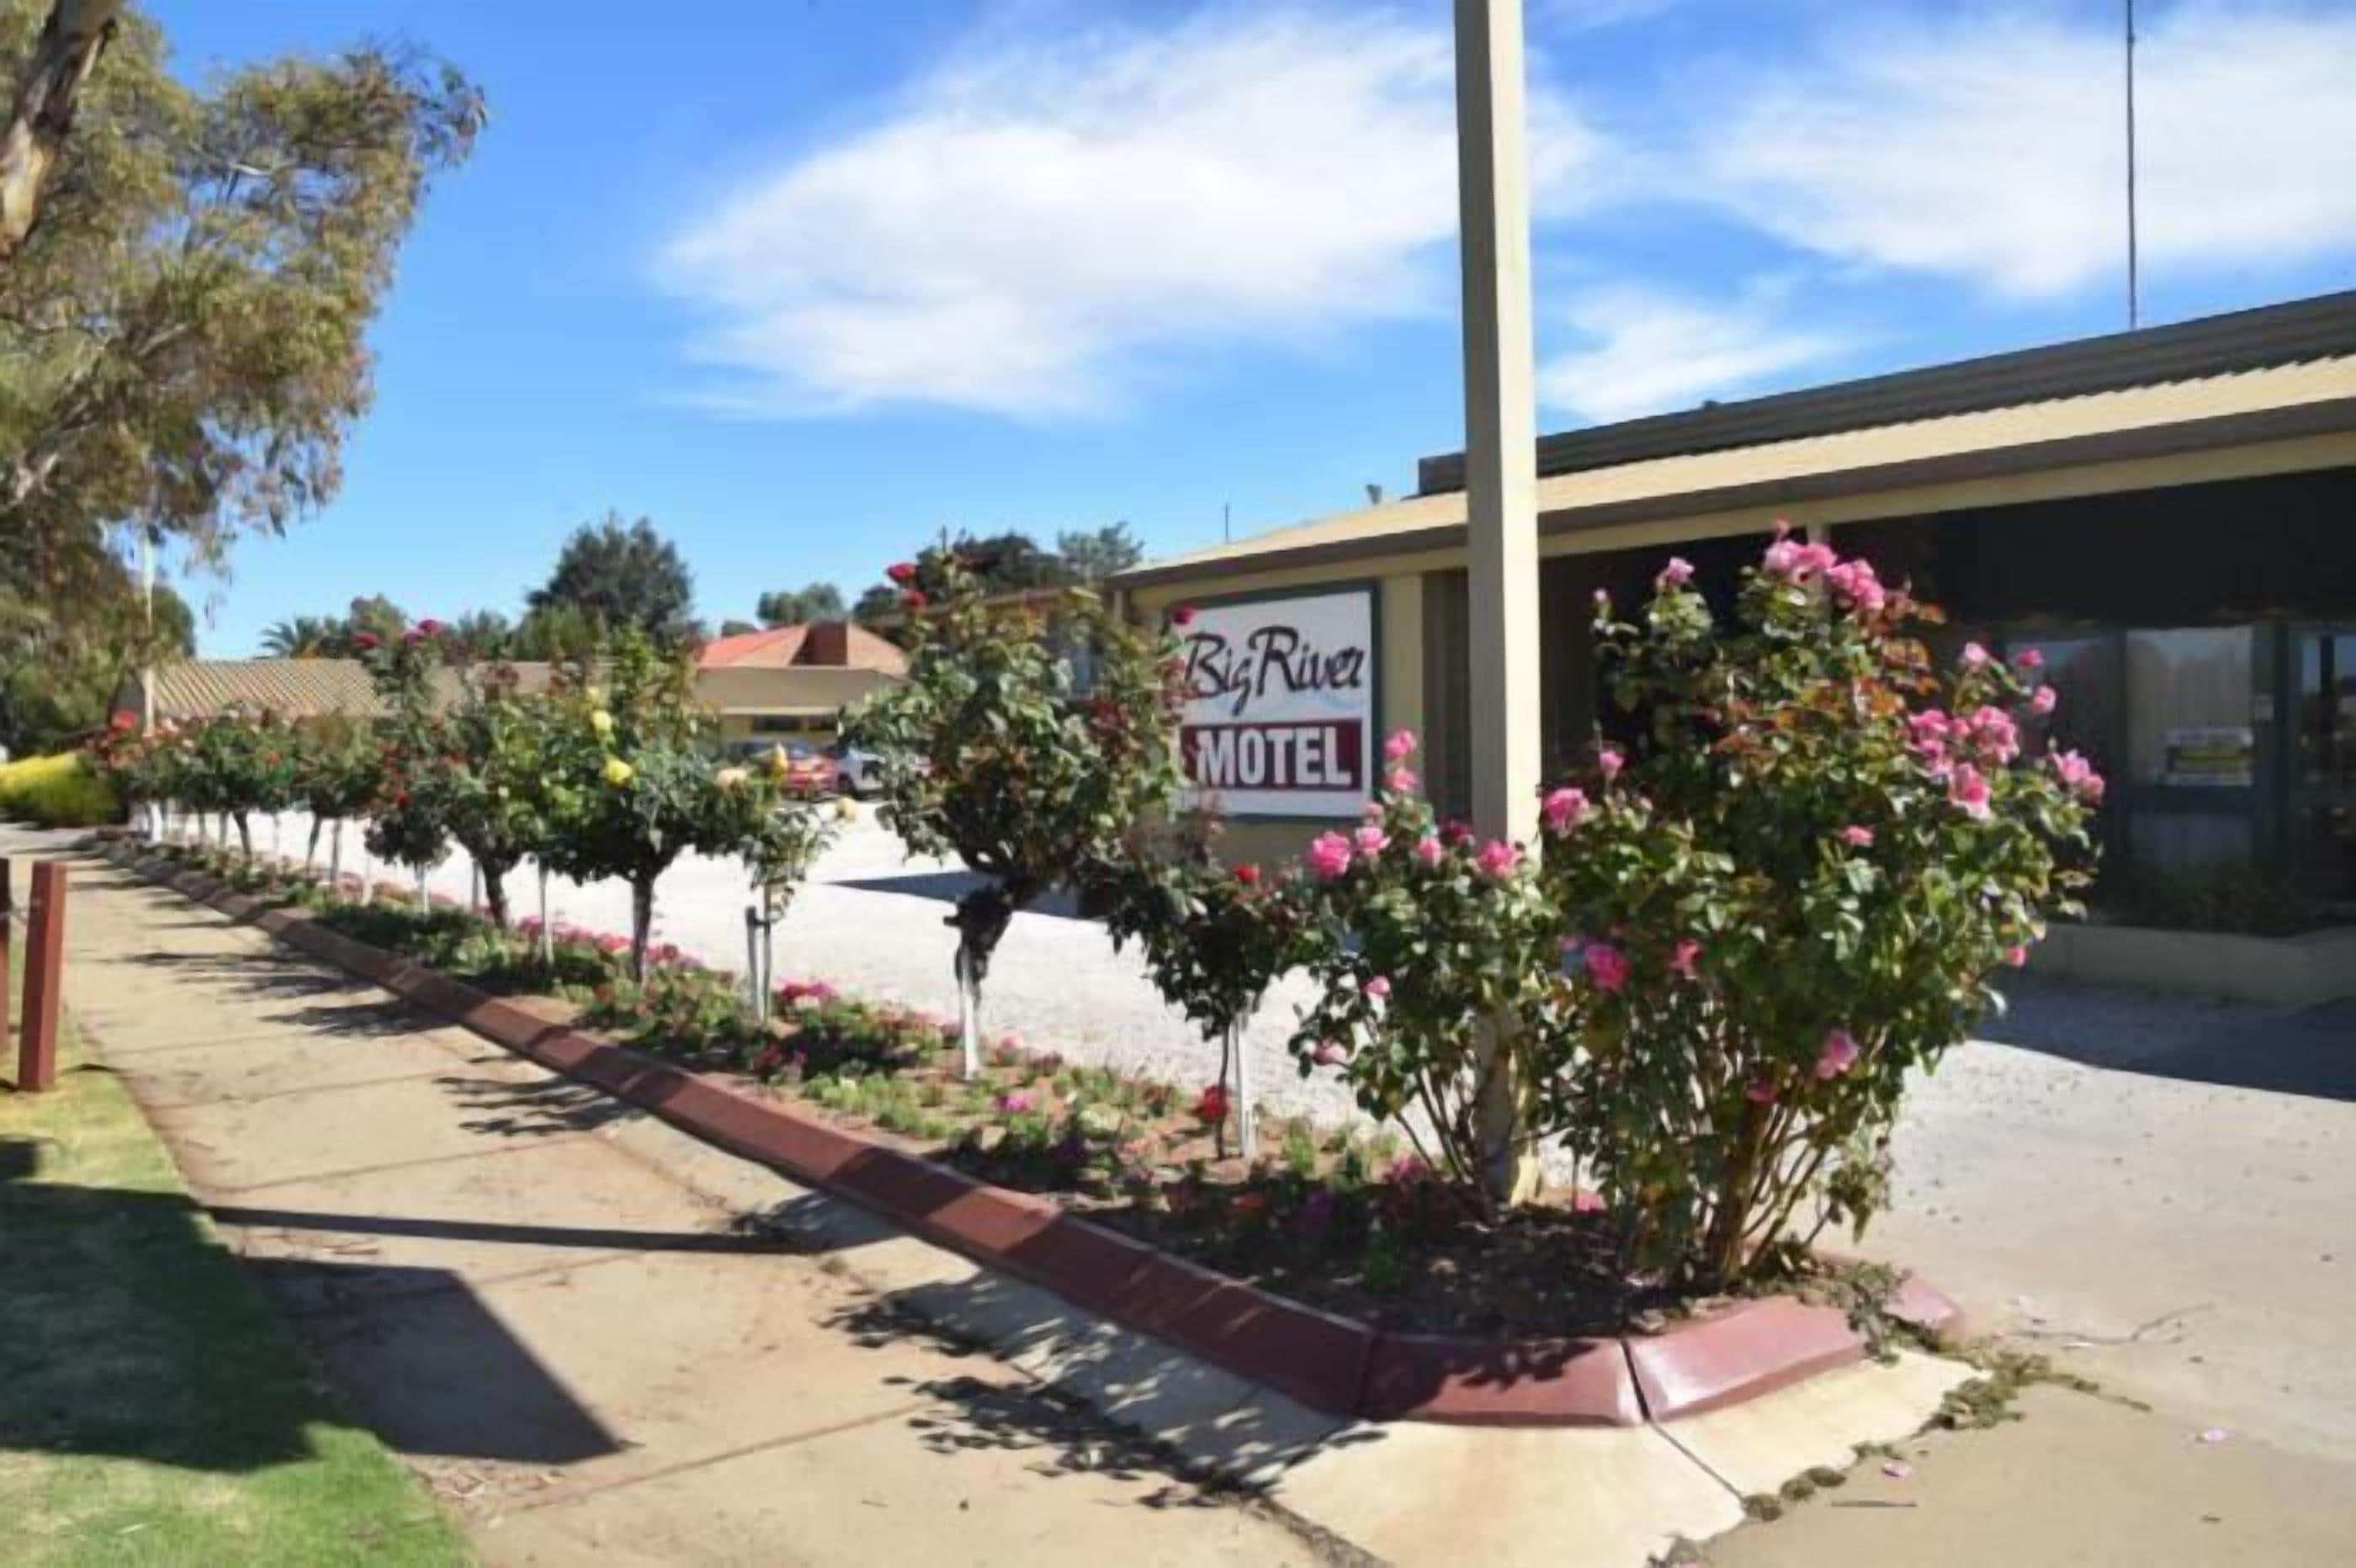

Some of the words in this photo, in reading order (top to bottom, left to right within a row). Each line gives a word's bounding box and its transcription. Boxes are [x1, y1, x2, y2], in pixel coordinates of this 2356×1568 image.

[1184, 632, 1252, 716] Big
[1248, 625, 1364, 697] River
[1195, 726, 1352, 787] MOTEL
